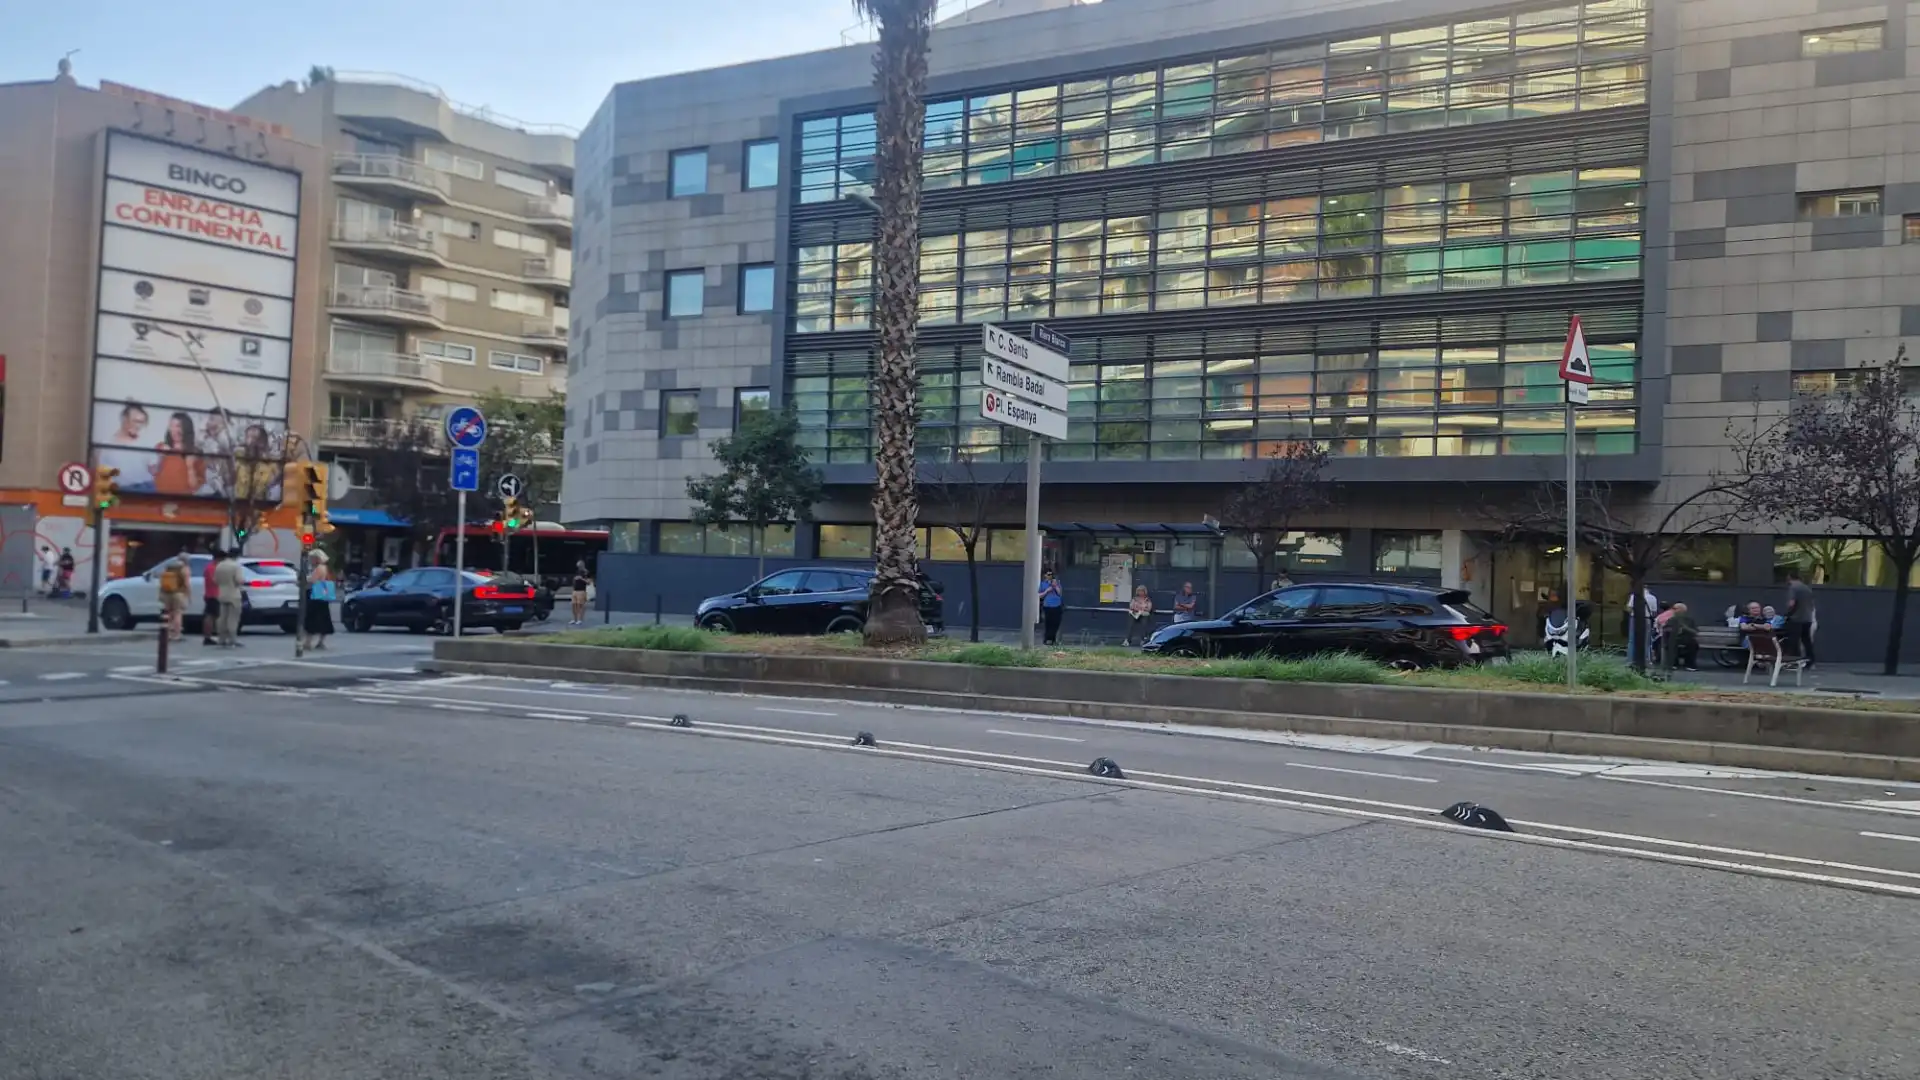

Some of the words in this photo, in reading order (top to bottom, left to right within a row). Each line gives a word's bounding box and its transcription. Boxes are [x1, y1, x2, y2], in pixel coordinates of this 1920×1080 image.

[168, 163, 247, 194] BINGO
[144, 188, 264, 228] ENRACHA
[115, 203, 288, 251] CONTINENTAL
[998, 334, 1006, 350] C.
[1008, 338, 1029, 359] Sants
[996, 366, 1024, 389] Rambla
[1025, 376, 1046, 396] Badal
[995, 397, 1005, 415] Pl.
[1007, 401, 1037, 426] Espanya
